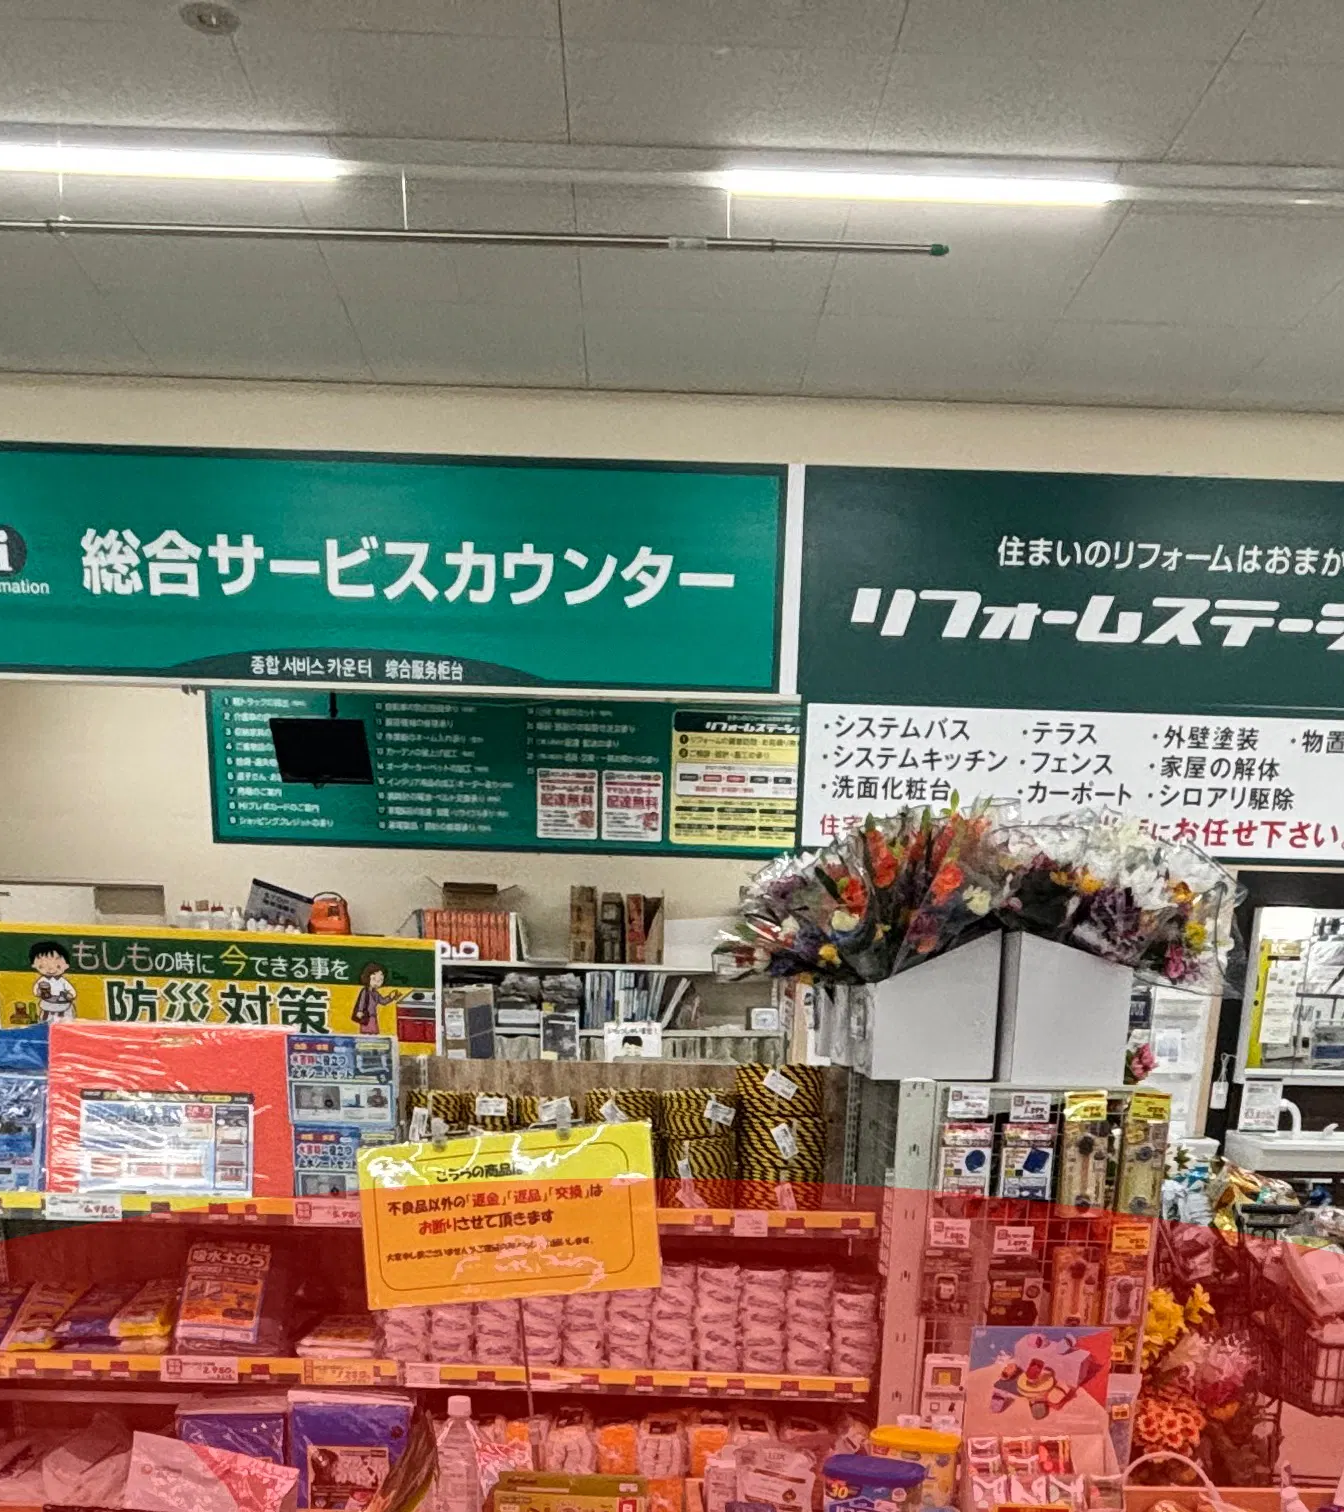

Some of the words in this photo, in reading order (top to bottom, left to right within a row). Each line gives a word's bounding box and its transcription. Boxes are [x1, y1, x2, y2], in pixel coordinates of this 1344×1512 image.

[81, 526, 736, 609] 総合サービスカウンター
[251, 655, 280, 677] 종합
[282, 656, 325, 678] 서비스
[328, 656, 373, 680] 카운터
[105, 978, 332, 1034] 防災対策
[419, 1208, 555, 1236] お断りさせて頂きます
